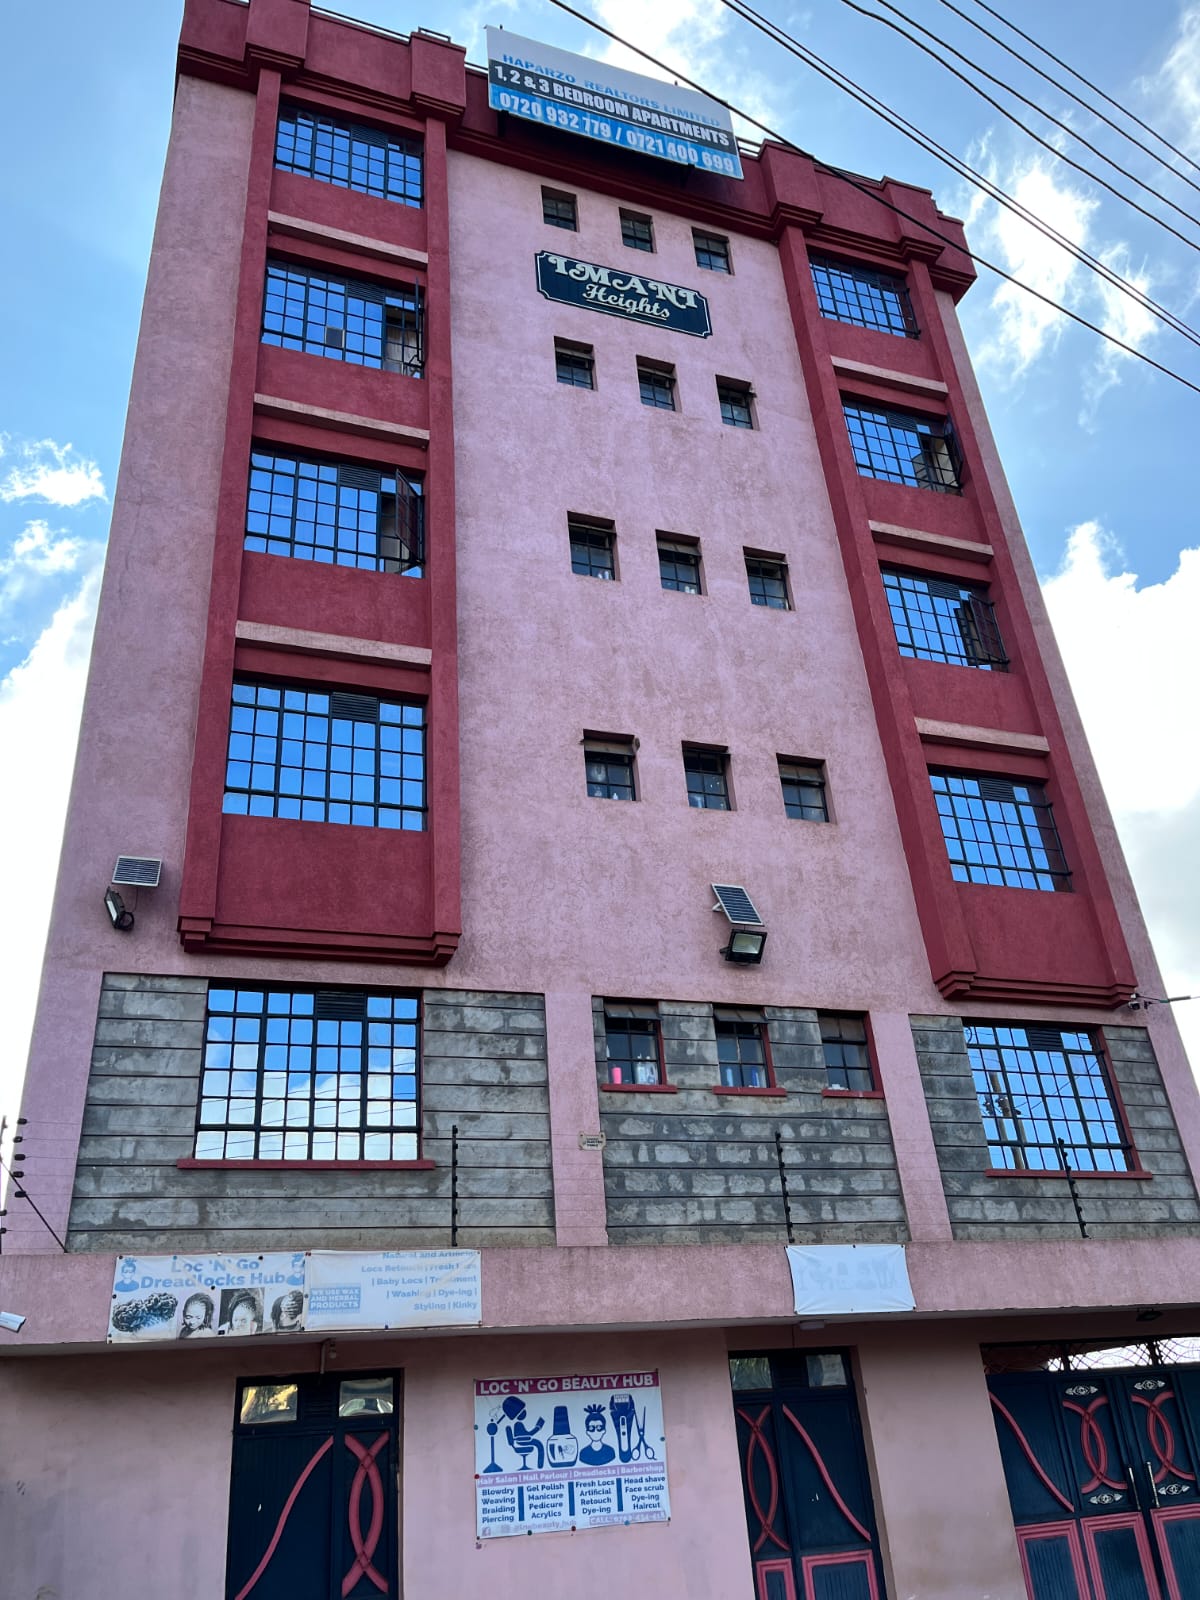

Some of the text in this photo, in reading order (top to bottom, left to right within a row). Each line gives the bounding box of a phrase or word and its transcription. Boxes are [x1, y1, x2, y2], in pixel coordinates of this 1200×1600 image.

[502, 53, 721, 127] HAPARZO REALTORS LIMITED
[510, 69, 521, 85] 2
[523, 74, 537, 90] &
[538, 78, 550, 93] 3
[552, 82, 630, 118] BEDROOM
[632, 105, 730, 147] APARTMENTS
[500, 92, 735, 174] 0720 932 779 / 0721 400 699
[547, 254, 698, 309] IMANI
[582, 283, 670, 318] Heights
[171, 1259, 204, 1273] Loc
[236, 1258, 260, 1271] Go
[361, 1264, 382, 1273] Locs
[140, 1270, 286, 1289] Dreadlocks Hub
[376, 1277, 400, 1286] Baby
[402, 1276, 423, 1285] Locs
[438, 1287, 473, 1297] Dye-ing
[310, 1301, 359, 1309] PRODUCTS
[413, 1300, 478, 1311] Styling Kinky
[480, 1382, 511, 1395] LOC
[537, 1378, 558, 1391] GO
[562, 1375, 619, 1390] BEAUTY
[622, 1374, 654, 1388] HUB
[478, 1476, 494, 1486] Hair
[495, 1475, 518, 1485] Salon
[522, 1473, 539, 1482] Nail
[573, 1467, 617, 1477] Dreadlocks
[620, 1464, 664, 1475] Barbershop
[624, 1475, 666, 1485] Head shave
[526, 1482, 565, 1492] Gel Polish
[575, 1479, 615, 1489] Fresh Locs
[624, 1484, 665, 1494] Face scrub
[481, 1487, 515, 1497] Blowdry
[527, 1491, 564, 1501] Manicure
[579, 1487, 612, 1497] Artificial
[481, 1496, 516, 1506] Weaving
[580, 1496, 612, 1506] Retouch
[631, 1493, 660, 1503] Dye-ing
[481, 1504, 516, 1515] Braiding
[528, 1500, 564, 1510] Pedicure
[582, 1505, 612, 1515] Dye-ing
[633, 1501, 661, 1511] Haircut
[481, 1513, 515, 1524] Piercing
[531, 1509, 562, 1519] Acrylics
